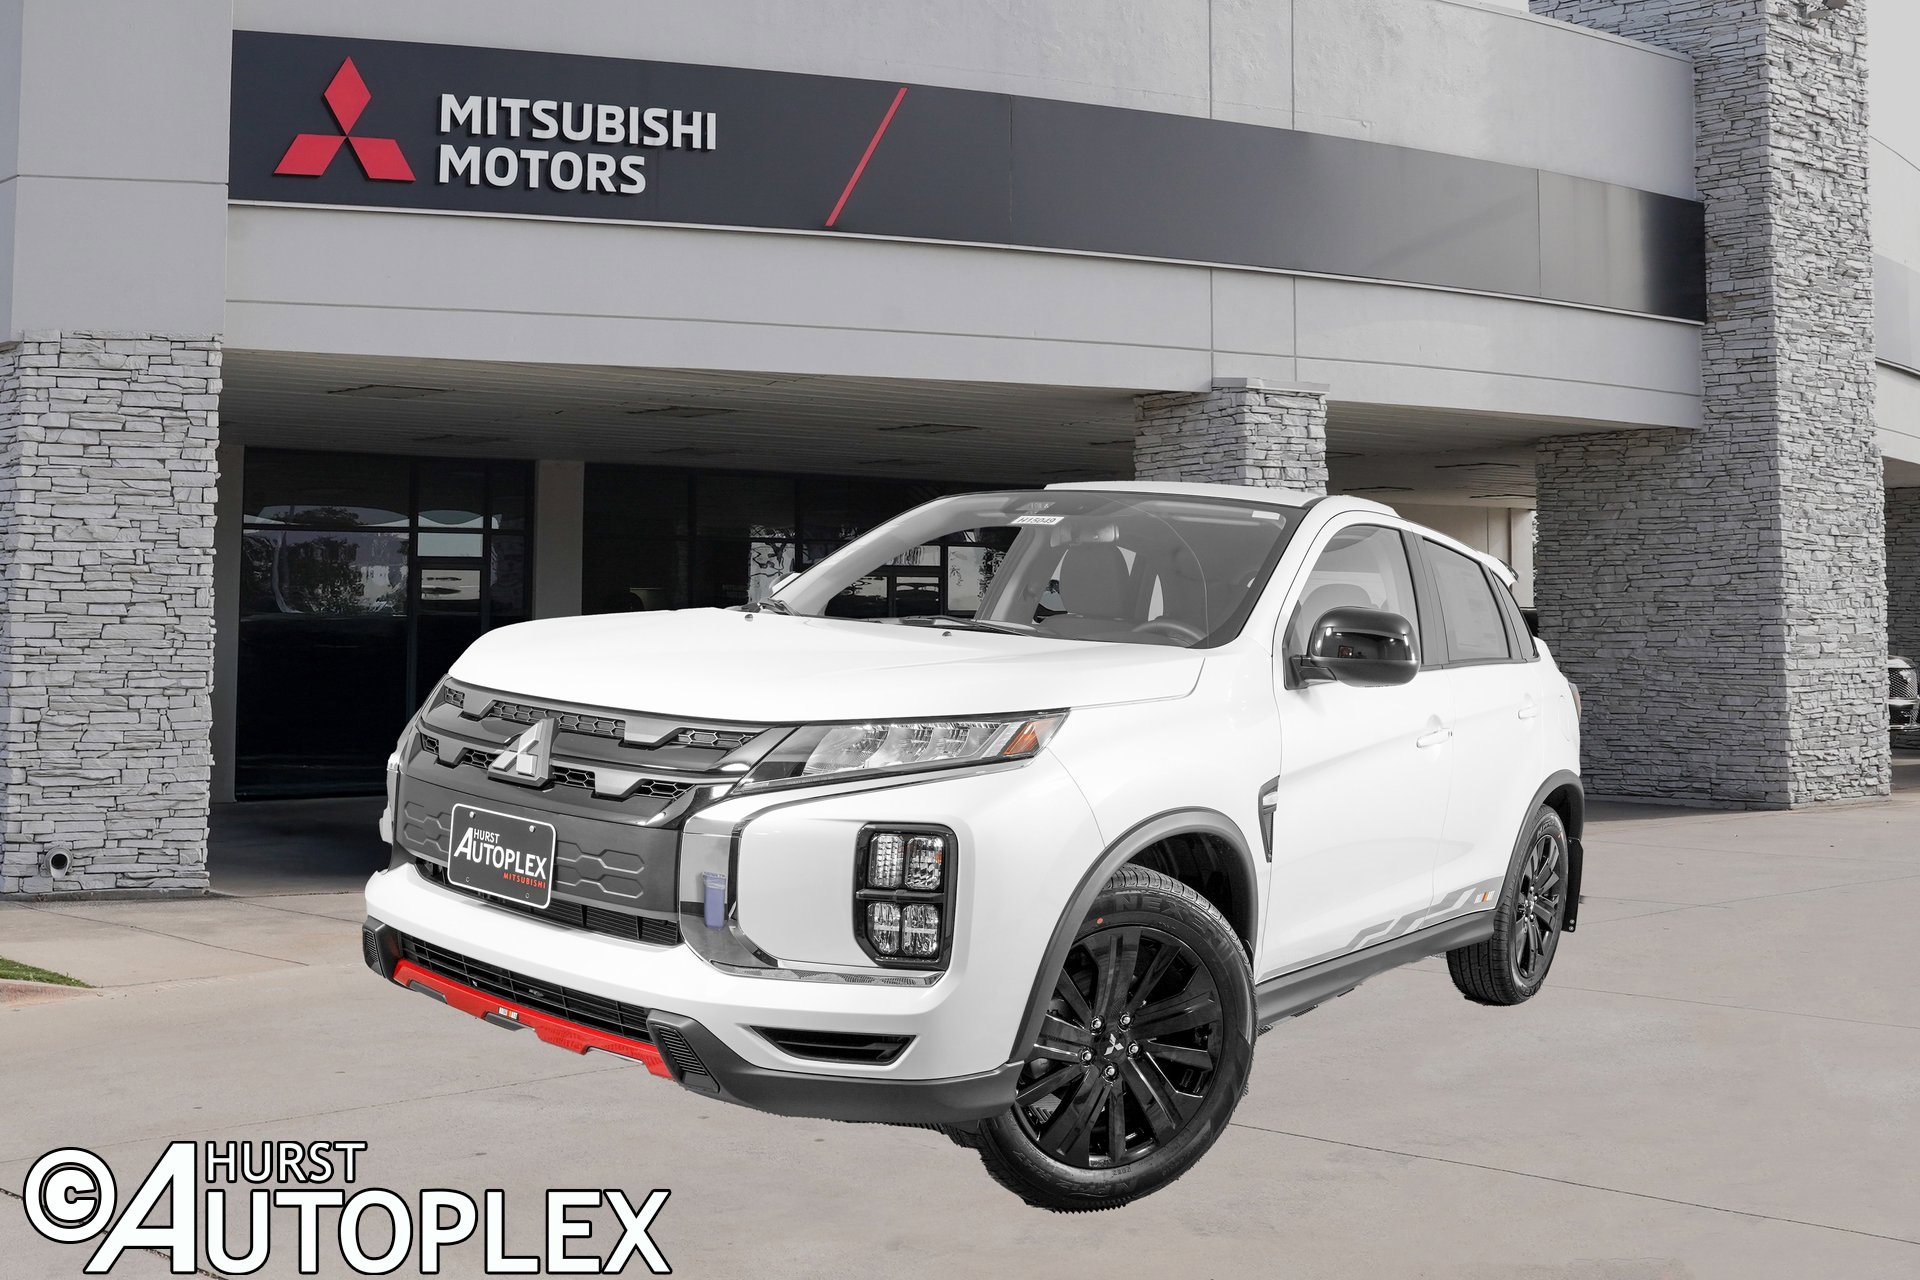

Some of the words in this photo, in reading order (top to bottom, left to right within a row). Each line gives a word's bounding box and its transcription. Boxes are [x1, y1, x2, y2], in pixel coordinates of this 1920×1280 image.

[440, 93, 717, 151] MITSUBISHI
[437, 145, 647, 194] MOTORS
[453, 827, 547, 880] AUTOPLEX
[473, 828, 500, 844] HURST
[503, 872, 547, 889] MITSUBISHI
